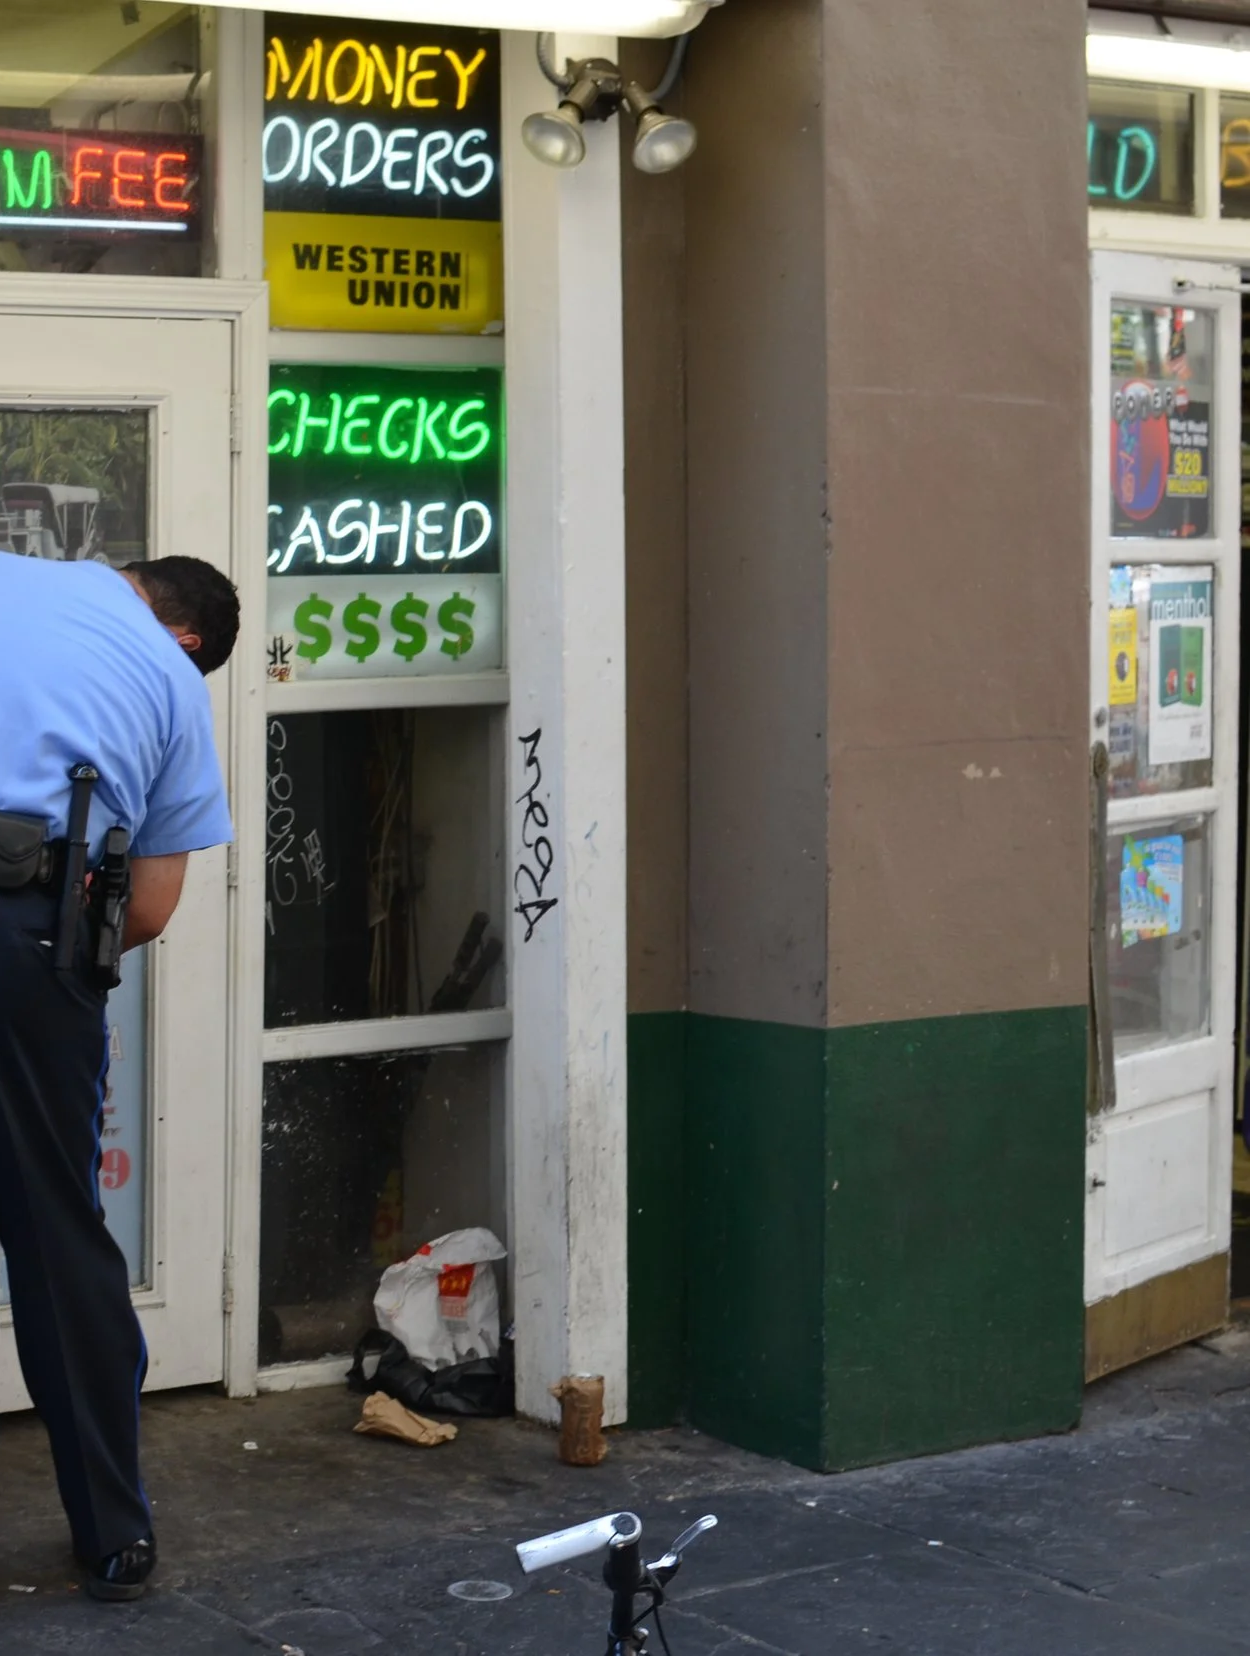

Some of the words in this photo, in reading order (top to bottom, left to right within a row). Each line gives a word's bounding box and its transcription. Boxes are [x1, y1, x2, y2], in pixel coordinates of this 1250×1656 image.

[265, 36, 487, 110] MONEY
[71, 147, 190, 211] FEE
[262, 115, 495, 198] ORDERS
[291, 242, 462, 278] WESTERN
[347, 278, 461, 310] UNION
[267, 388, 491, 464] CHECKS
[1174, 447, 1202, 476] $20
[1151, 583, 1211, 620] menthol
